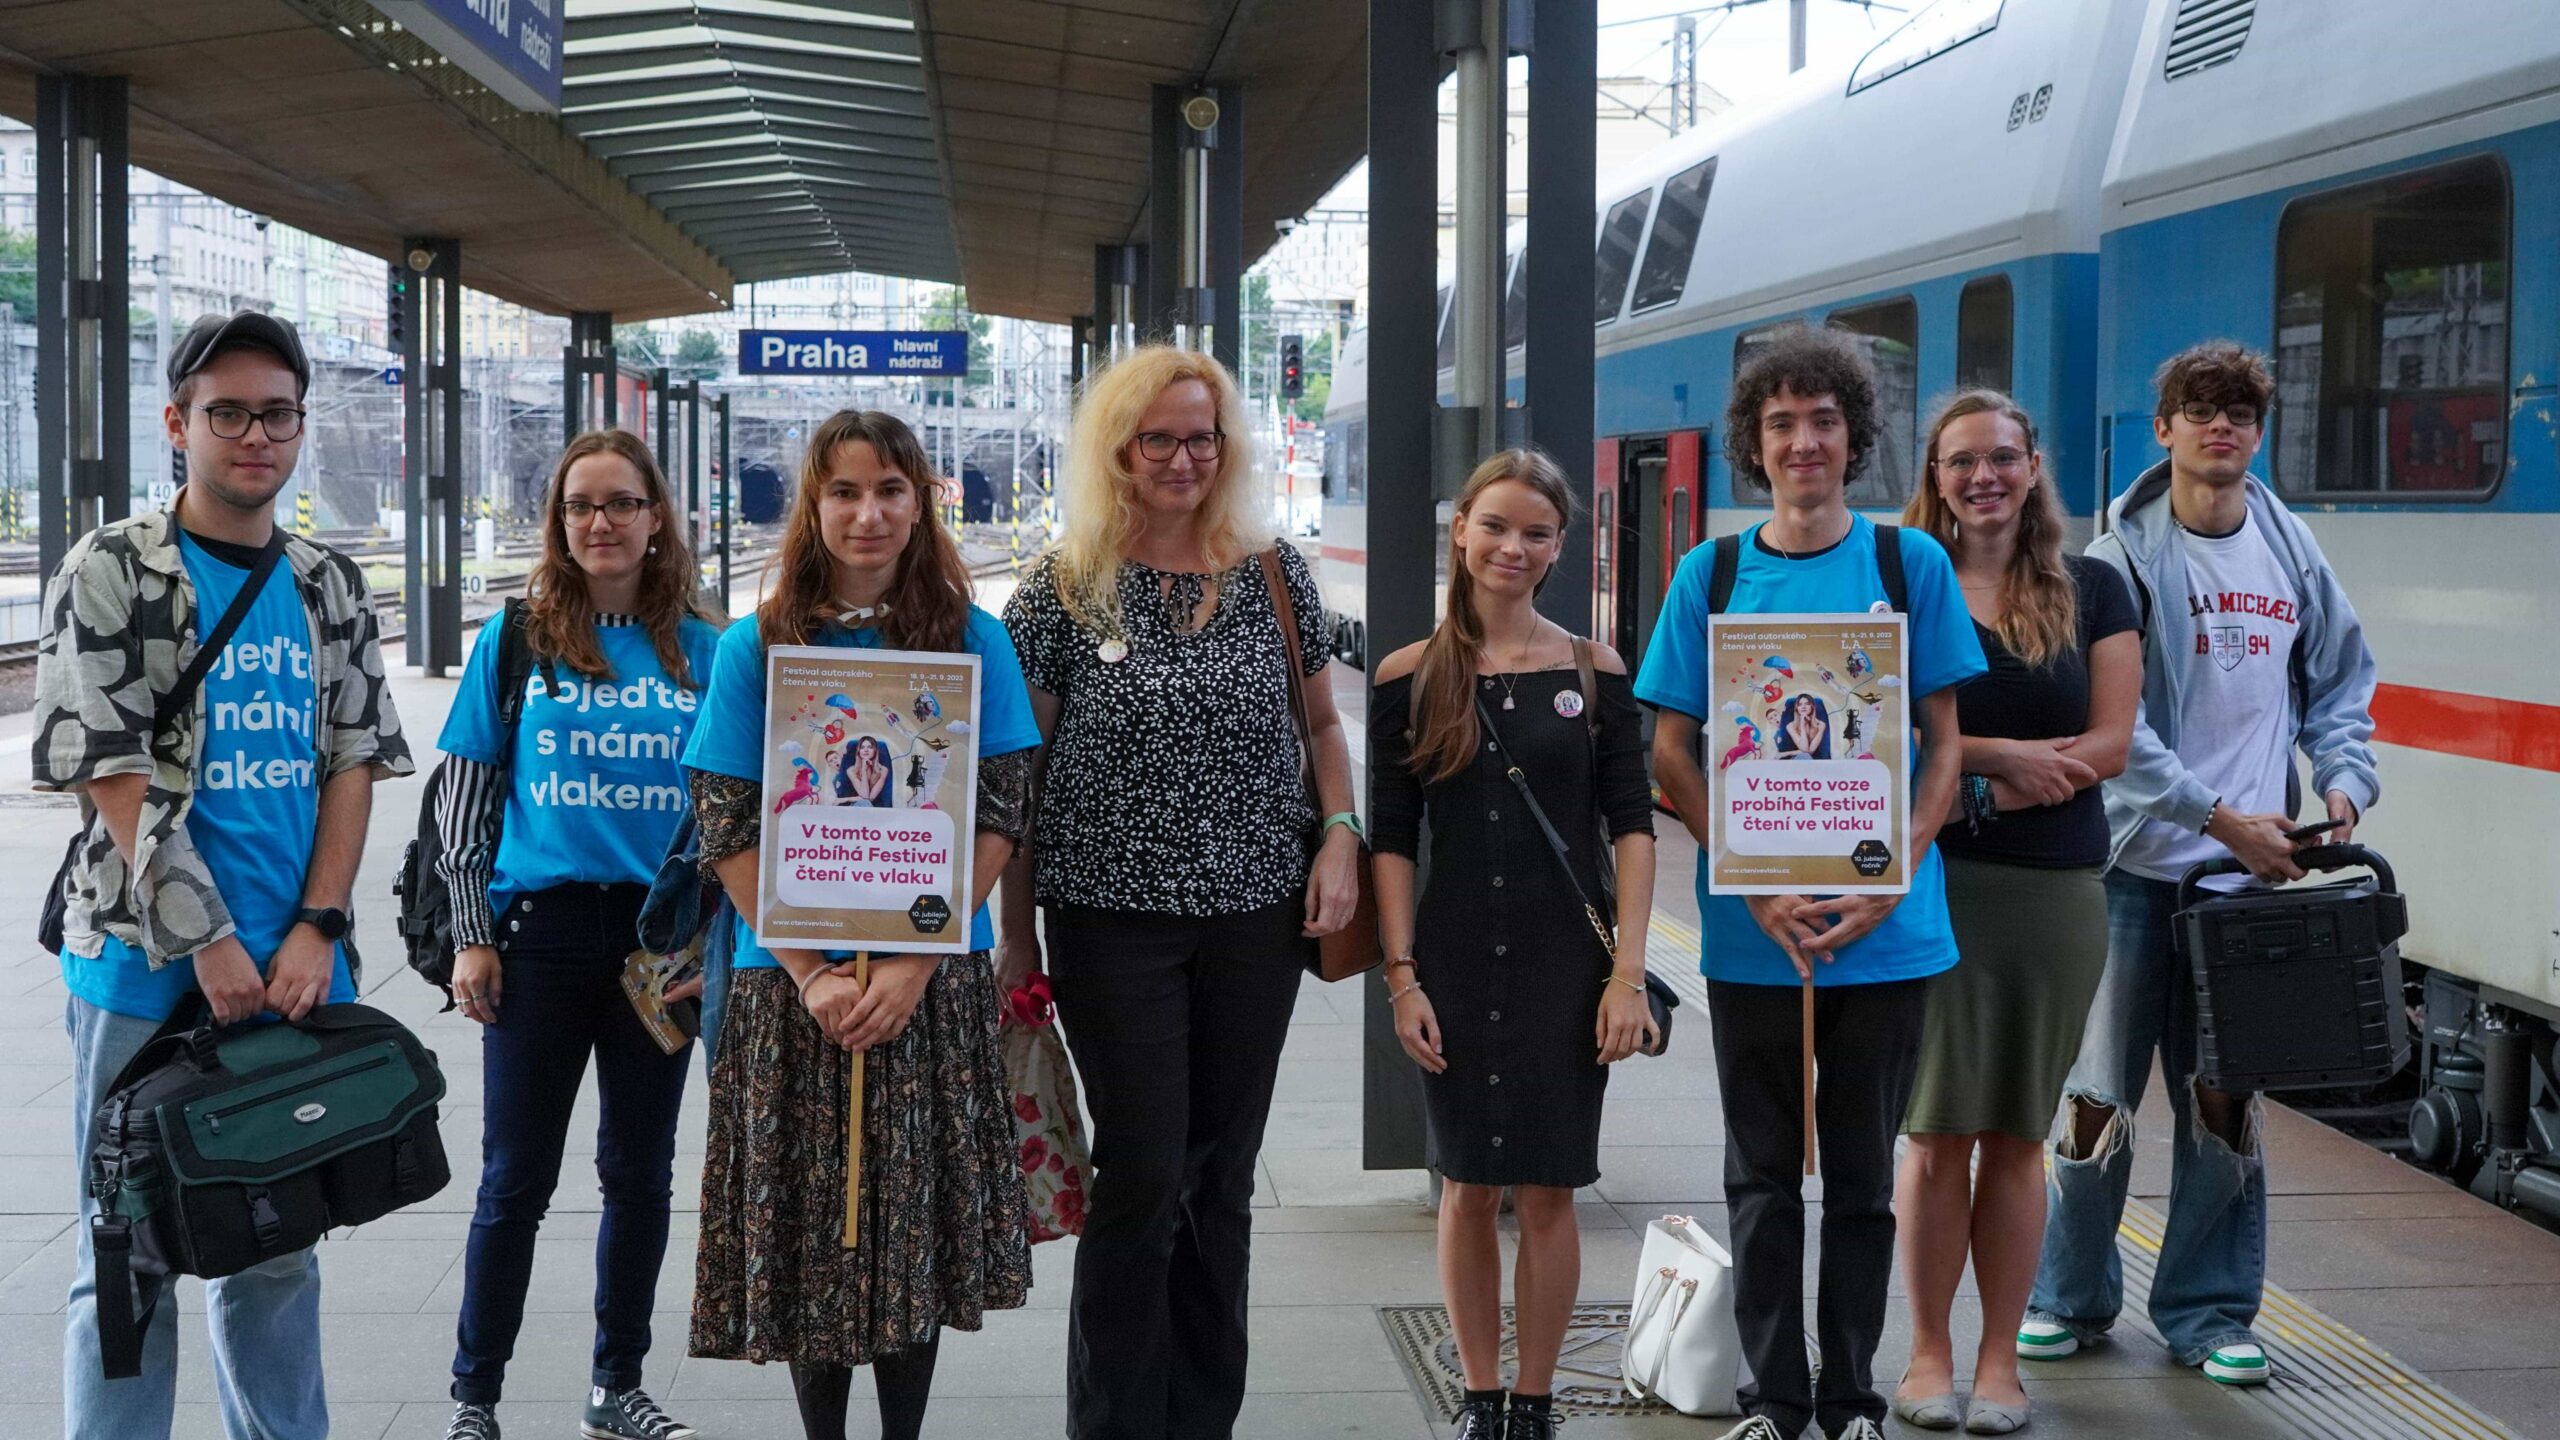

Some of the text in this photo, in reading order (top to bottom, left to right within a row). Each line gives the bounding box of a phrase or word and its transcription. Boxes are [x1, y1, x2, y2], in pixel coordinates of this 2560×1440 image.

[761, 337, 867, 368] Praha
[893, 339, 939, 352] hlavní
[889, 355, 943, 369] nádraží
[387, 370, 398, 382] A
[1722, 632, 1756, 640] Festival
[2248, 634, 2270, 655] 94
[782, 666, 874, 679] Festival autorského
[782, 677, 807, 686] čtení
[821, 679, 846, 688] vlaku
[525, 674, 697, 713] Pojeďte
[536, 723, 682, 761] s námi
[530, 771, 682, 812] vlakem
[1746, 778, 1870, 791] V tomto voze
[1732, 796, 1885, 814] probíhá Festival
[1743, 816, 1873, 831] čtení ve vlaku
[802, 824, 932, 843] V tomto voze
[785, 844, 947, 864] probíhá Festival
[795, 865, 934, 884] čtení ve vlaku
